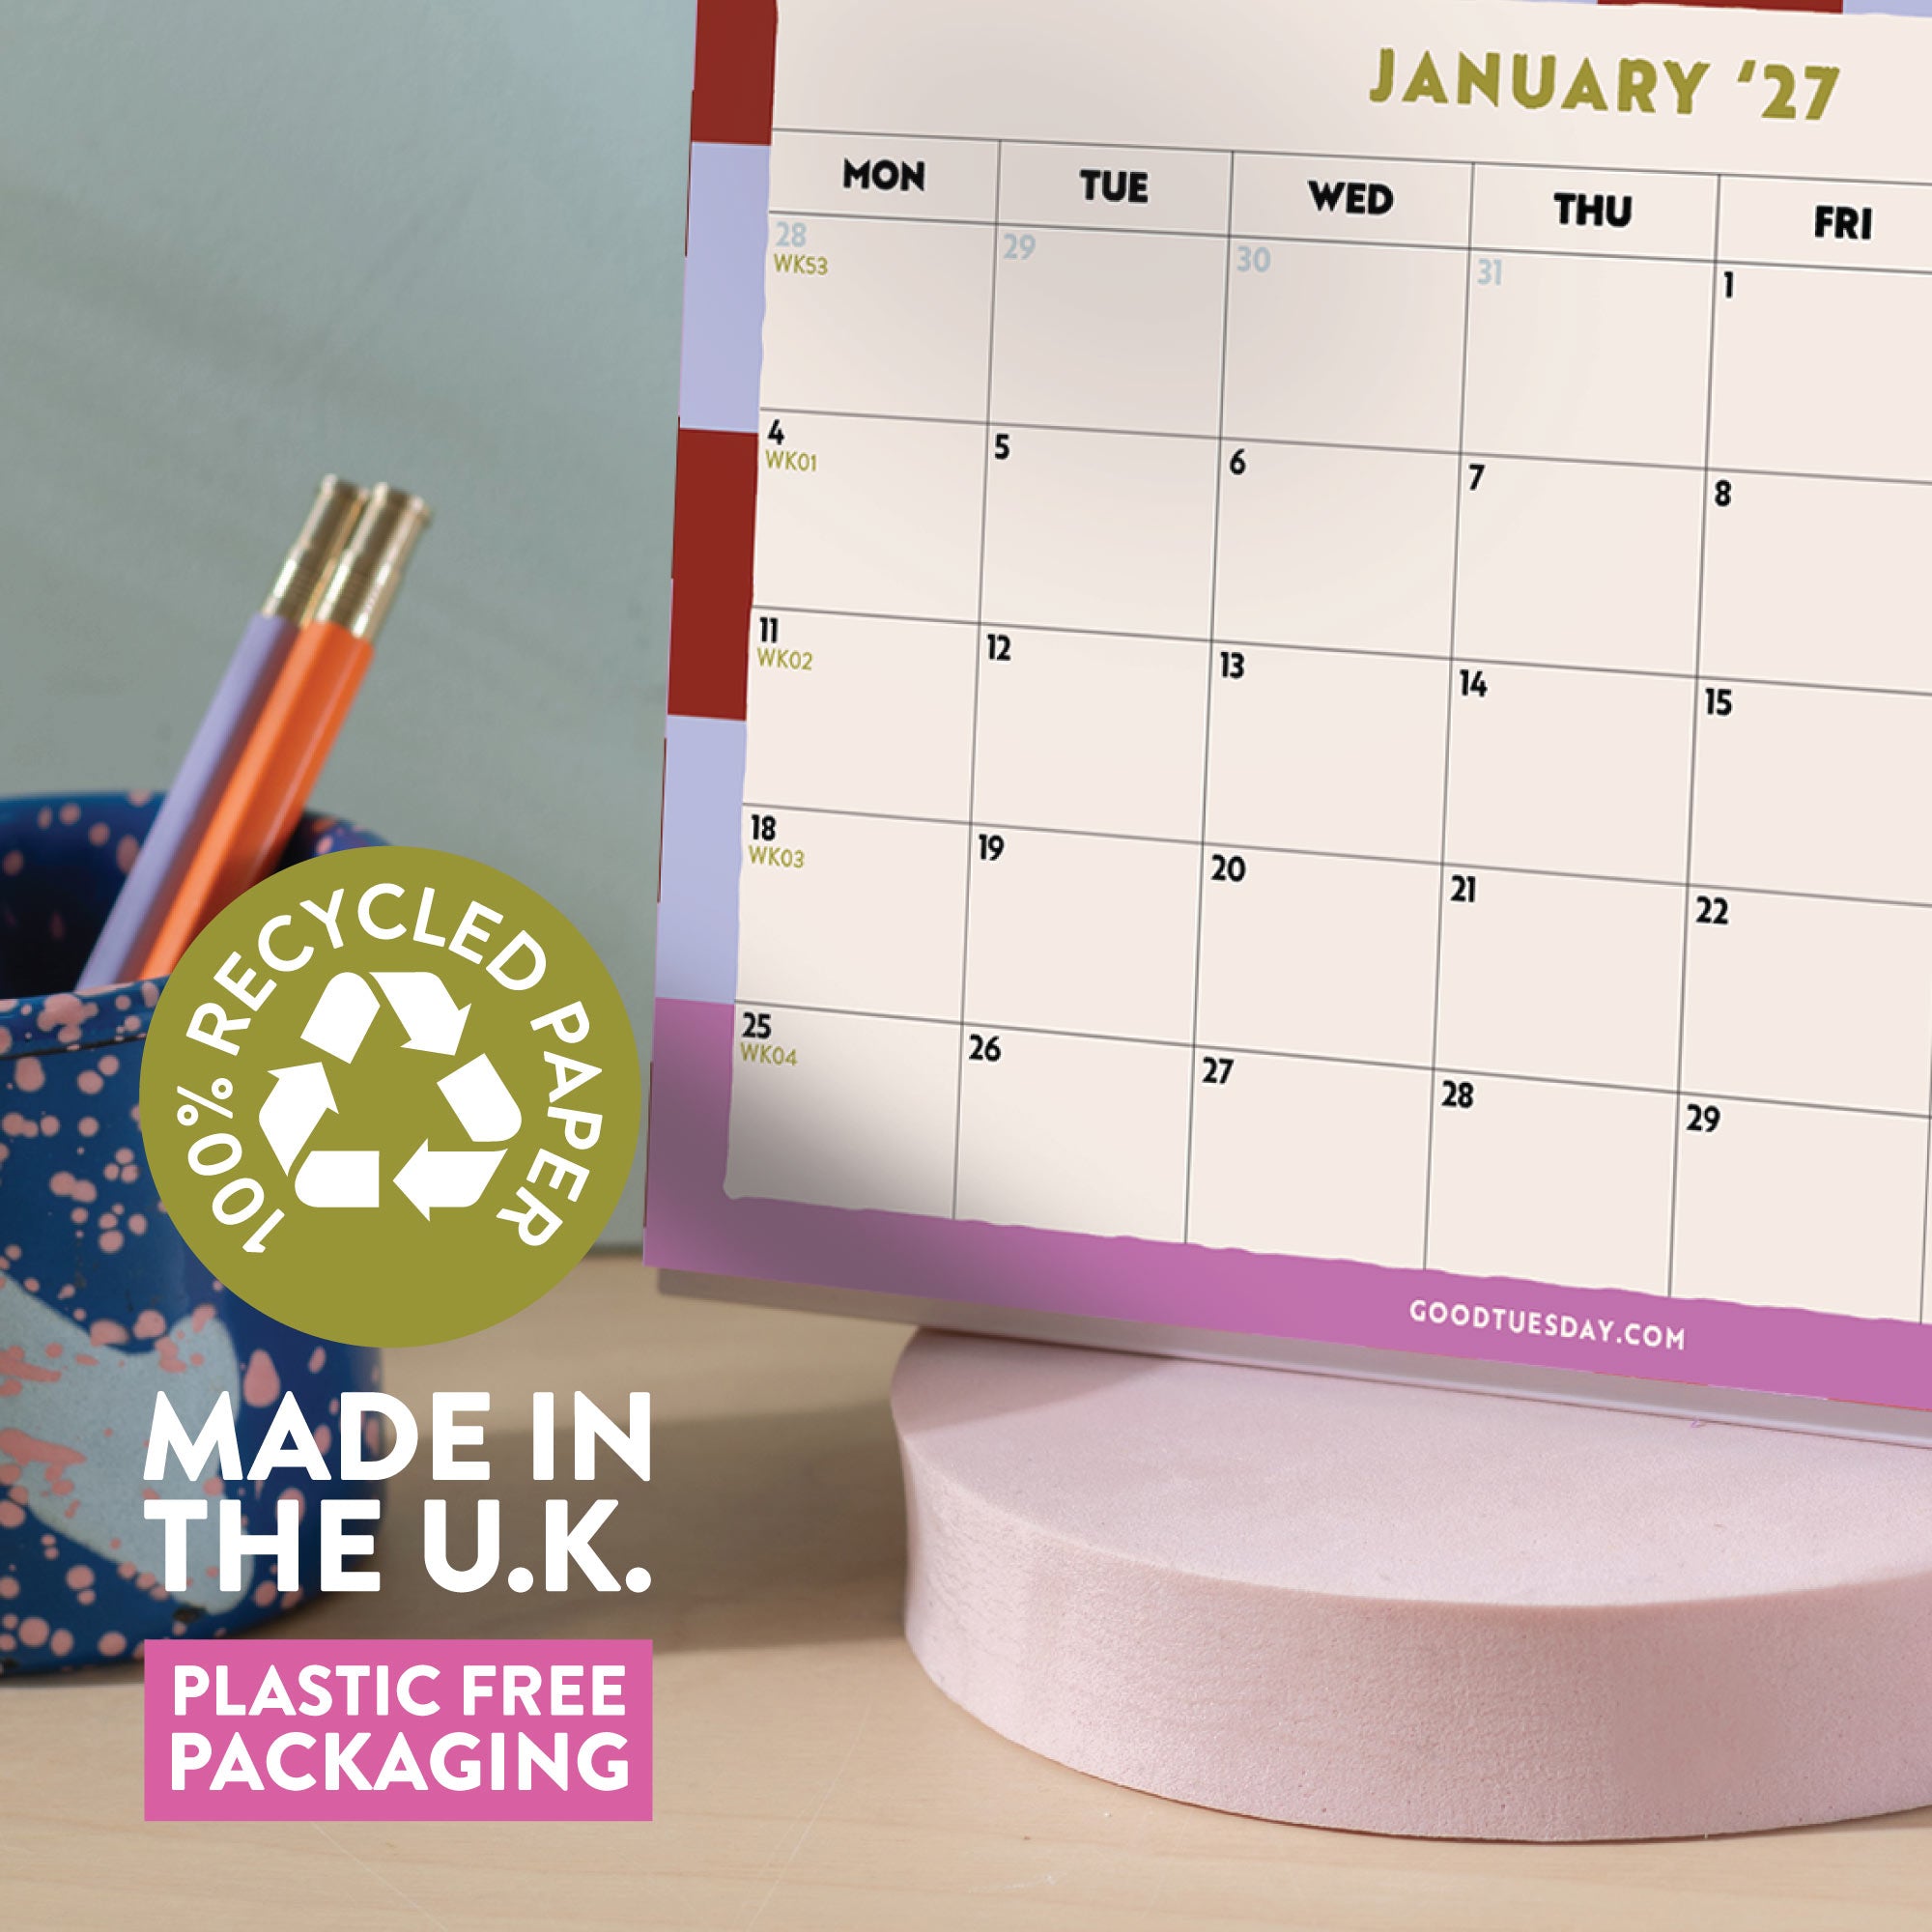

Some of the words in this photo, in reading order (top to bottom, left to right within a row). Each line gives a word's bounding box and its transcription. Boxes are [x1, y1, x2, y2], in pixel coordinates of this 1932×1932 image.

[1370, 47, 1710, 115] JANUARY
[843, 158, 924, 192] MON
[1080, 169, 1148, 203] TUE
[1308, 180, 1394, 215] WED
[1553, 192, 1633, 228] THU
[1814, 205, 1872, 241] FRI
[773, 255, 828, 275] WK53
[775, 222, 807, 247] 28
[1003, 235, 1037, 261] 29
[1236, 246, 1271, 273] 30
[1477, 259, 1502, 286] 31
[1723, 270, 1734, 298] 1
[765, 450, 817, 471] WK01
[768, 419, 785, 444] 4
[994, 434, 1010, 460] 5
[1229, 448, 1246, 475] 6
[1468, 463, 1485, 491] 7
[1715, 479, 1732, 507] 8
[756, 649, 812, 669] WK02
[759, 617, 778, 643] 11
[986, 635, 1011, 661] 12
[1220, 651, 1244, 678] 13
[1459, 668, 1488, 696] 14
[1705, 688, 1732, 716] 15
[748, 846, 805, 868] WK03
[751, 814, 776, 841] 18
[978, 834, 1005, 861] 19
[1210, 854, 1245, 882] 20
[1450, 875, 1475, 903] 21
[1695, 896, 1729, 924] 22
[740, 1044, 798, 1066] WK04
[742, 1012, 771, 1038] 25
[969, 1035, 1002, 1062] 26
[1203, 1058, 1234, 1085] 27
[1441, 1080, 1474, 1108] 28
[1687, 1104, 1720, 1132] 29
[1408, 1298, 1686, 1350] GOODTUESDAY.COM
